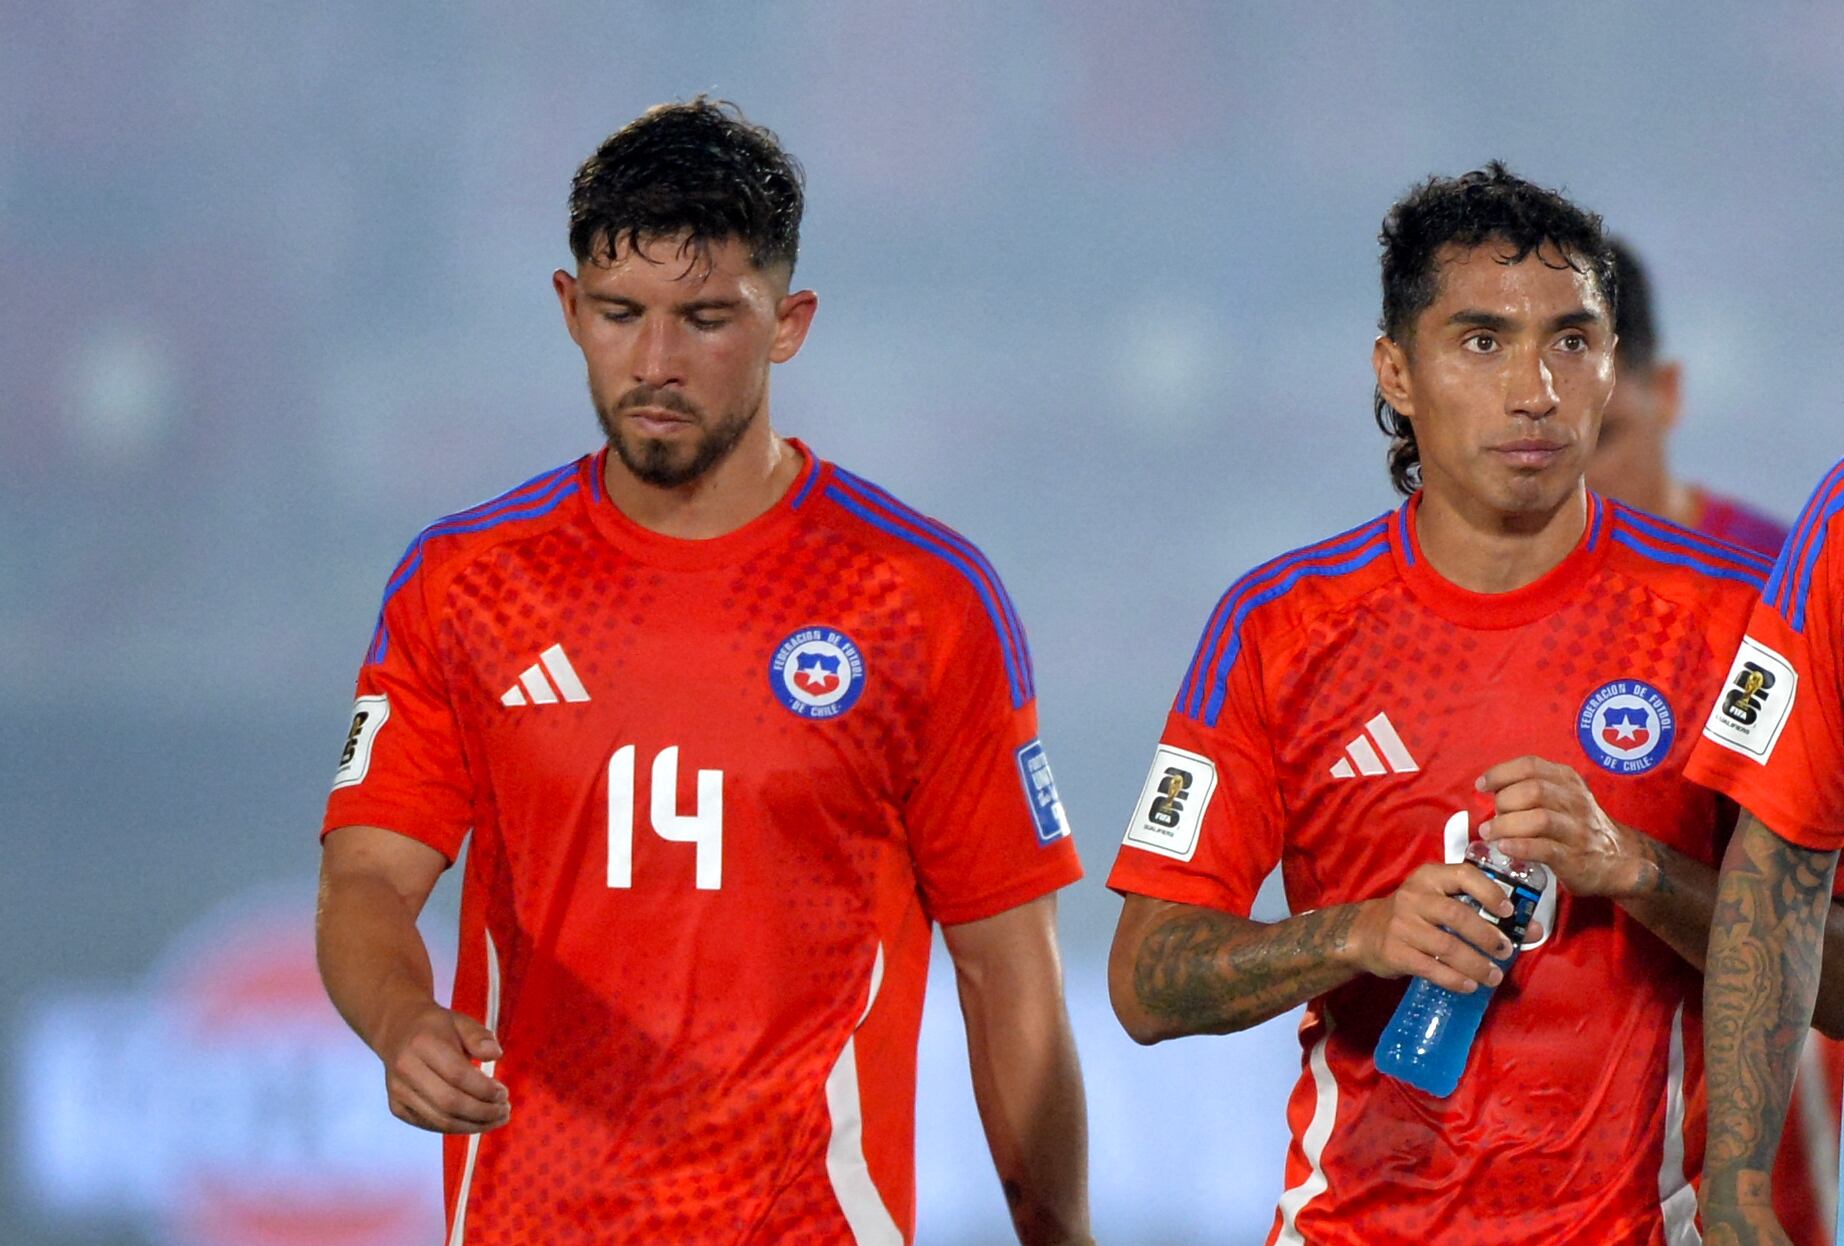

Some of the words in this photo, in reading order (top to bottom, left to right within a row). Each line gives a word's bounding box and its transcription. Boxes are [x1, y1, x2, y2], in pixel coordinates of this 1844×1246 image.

[1580, 683, 1626, 729] FEDERACION
[1633, 684, 1648, 698] DE
[1648, 694, 1671, 731] FUTBOL
[1603, 756, 1617, 769] DE
[1623, 756, 1652, 771] CHILE
[607, 744, 723, 889] 14
